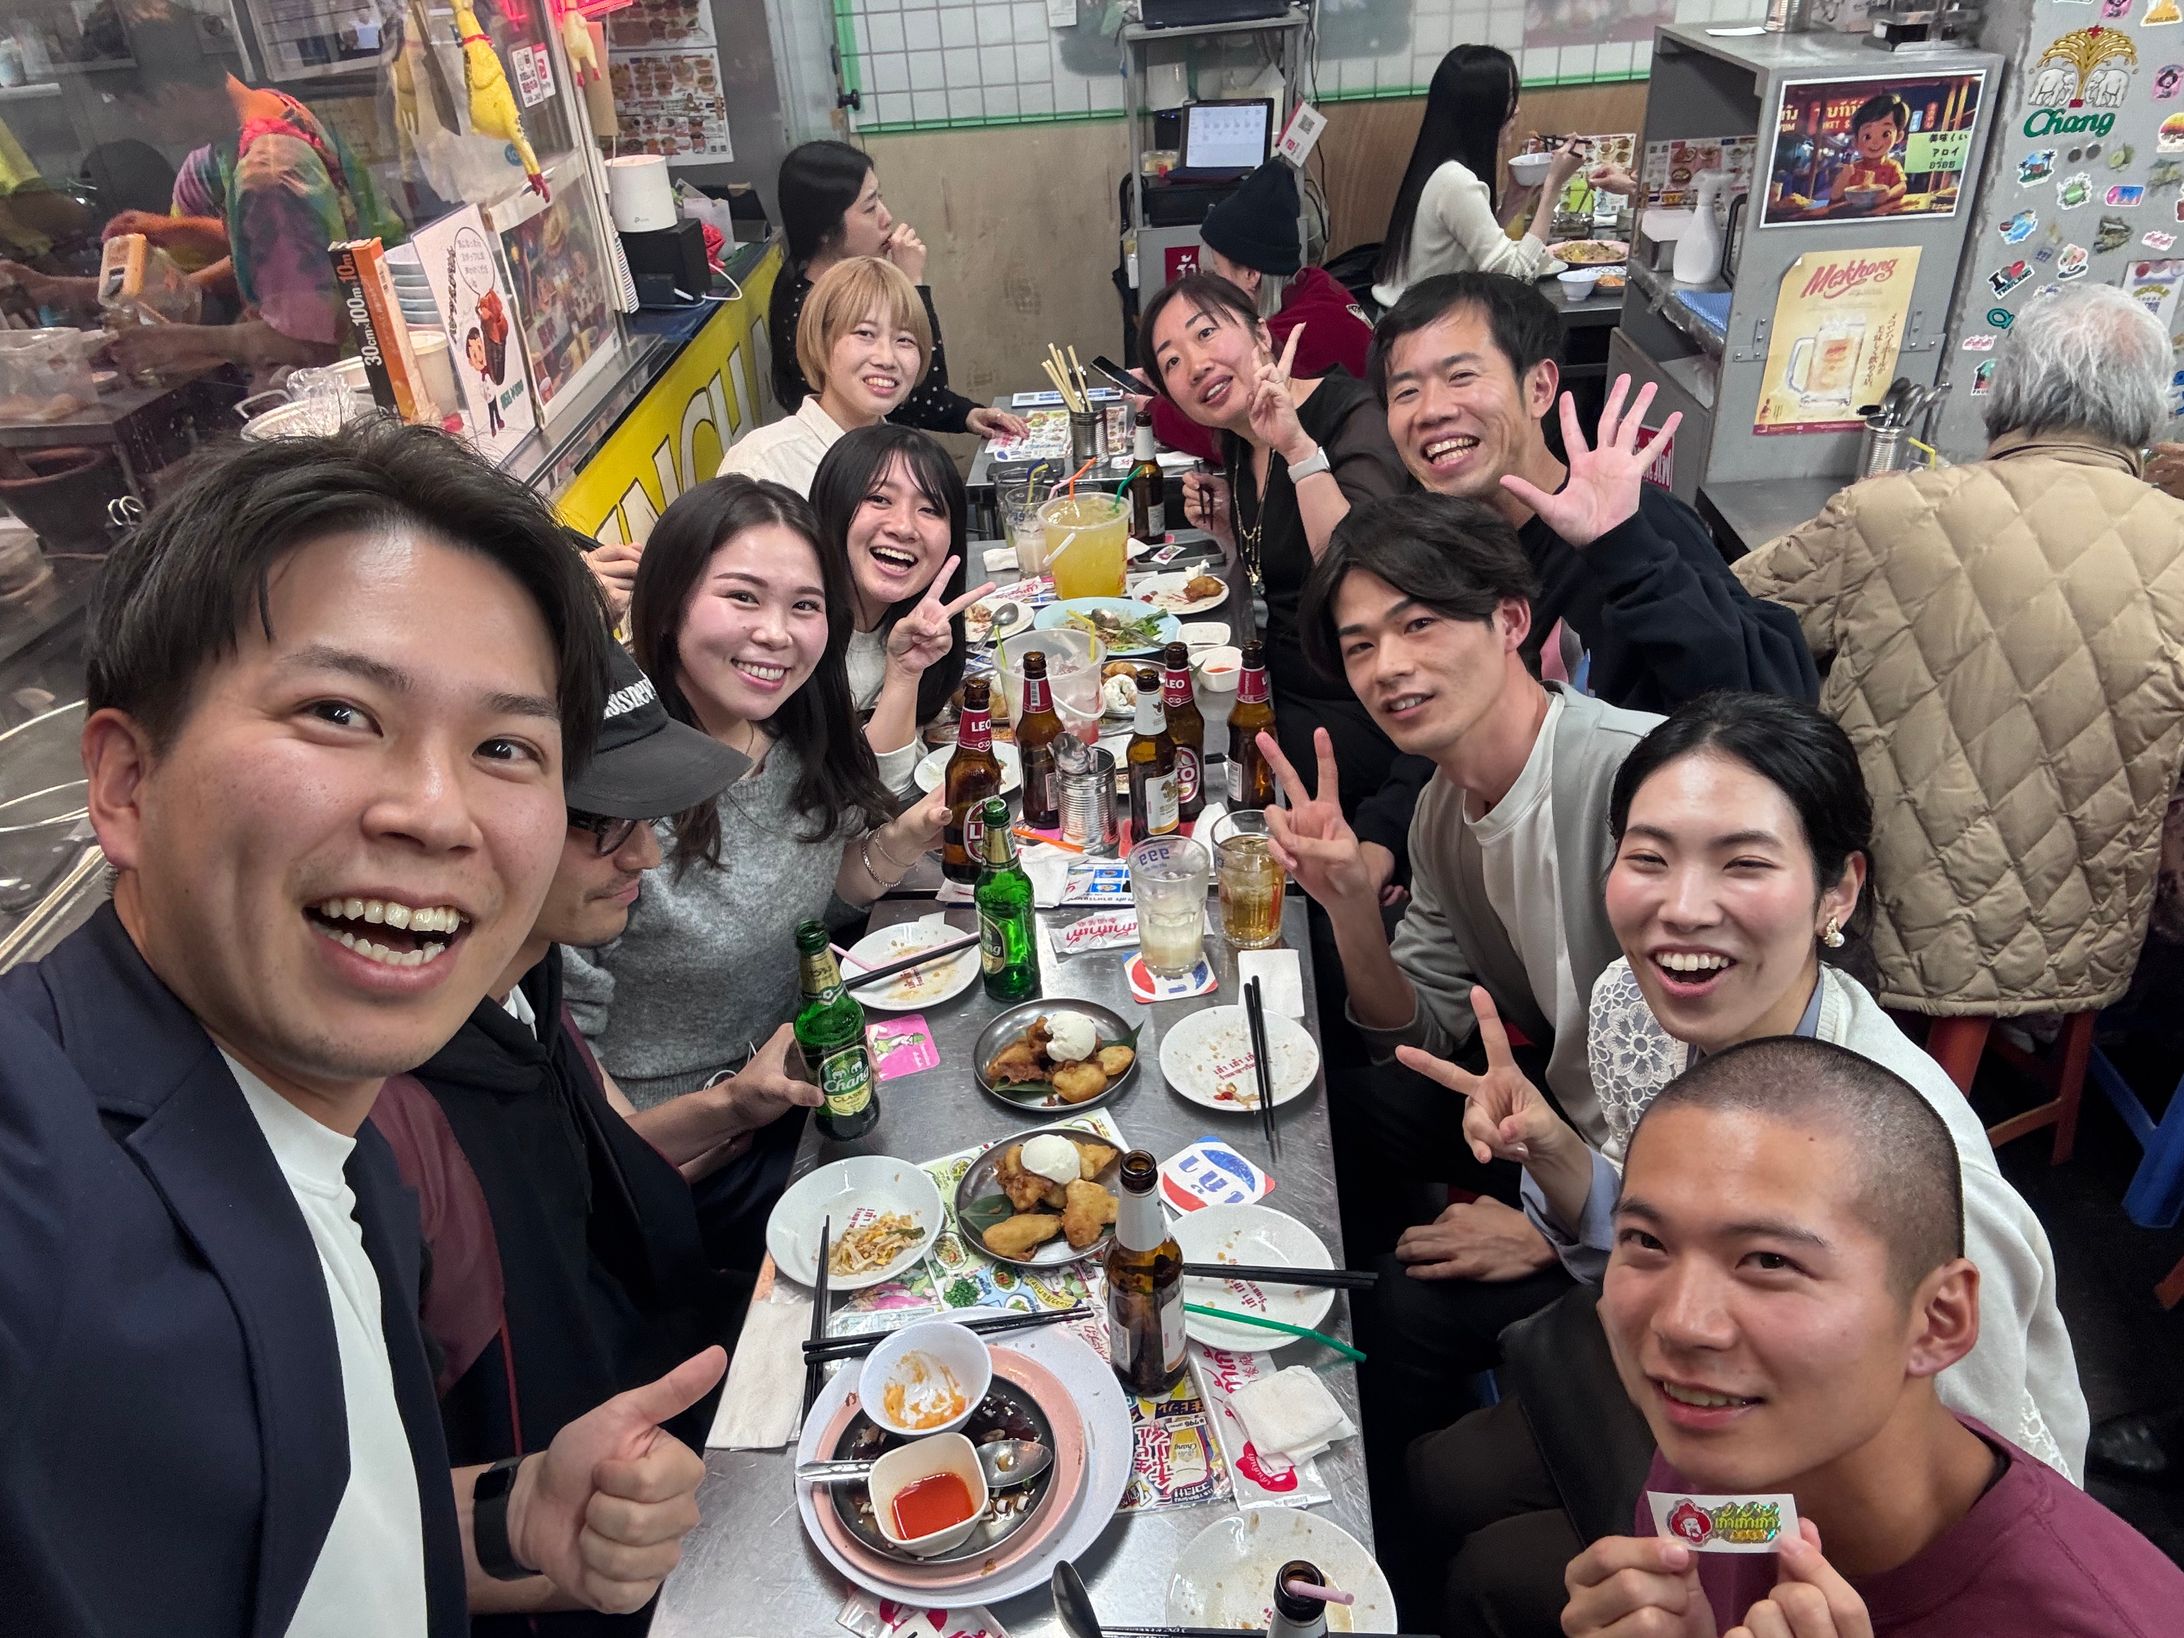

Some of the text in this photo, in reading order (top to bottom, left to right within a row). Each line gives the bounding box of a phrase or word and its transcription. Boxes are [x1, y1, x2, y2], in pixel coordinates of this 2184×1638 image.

[2023, 108, 2116, 138] Chang
[1932, 147, 1959, 157] アロイ
[1800, 258, 1899, 299] Mekhong
[1165, 678, 1185, 689] LEO
[971, 720, 992, 733] LEO
[823, 1065, 869, 1092] Chang
[1174, 1442, 1197, 1452] Chang
[1149, 1428, 1173, 1489] チャーン
